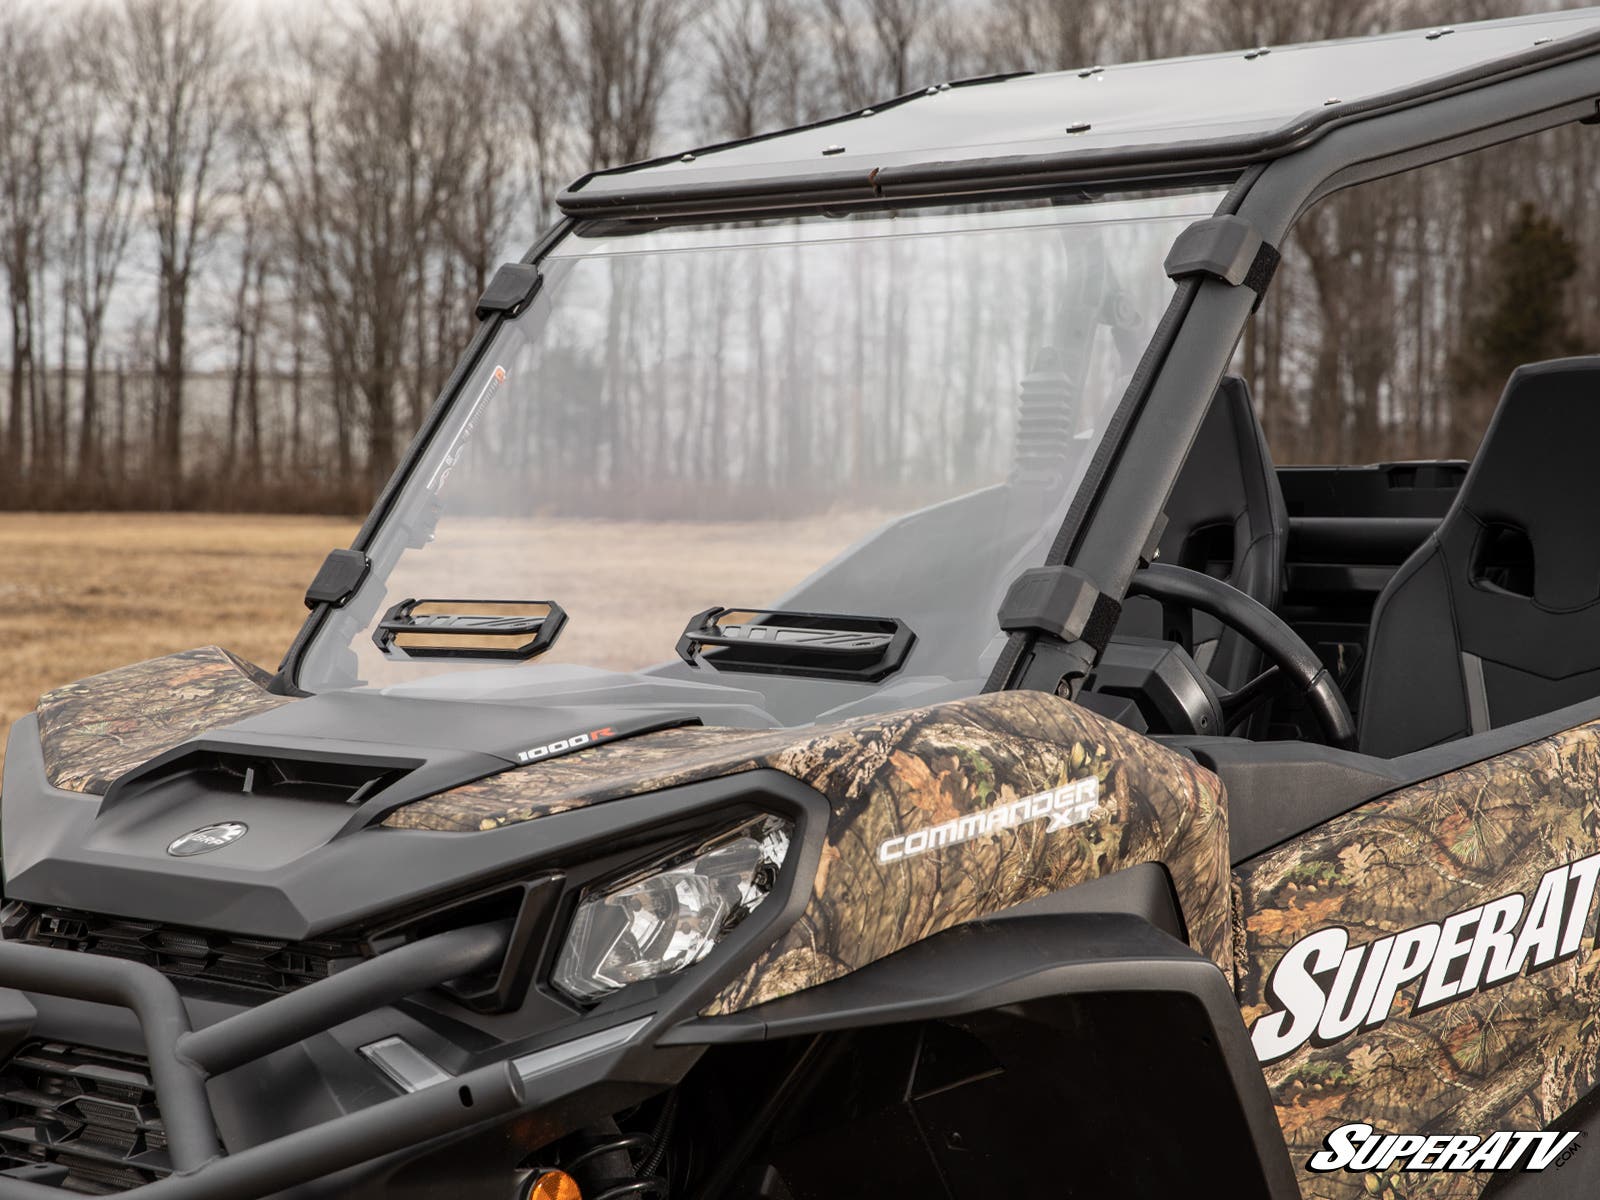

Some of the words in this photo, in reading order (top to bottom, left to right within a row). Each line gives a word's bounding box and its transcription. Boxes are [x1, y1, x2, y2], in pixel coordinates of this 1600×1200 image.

[518, 727, 616, 761] 1000R
[879, 779, 1099, 862] COMMANDER
[1048, 804, 1095, 832] XT
[1251, 853, 1600, 1062] SUPERAT
